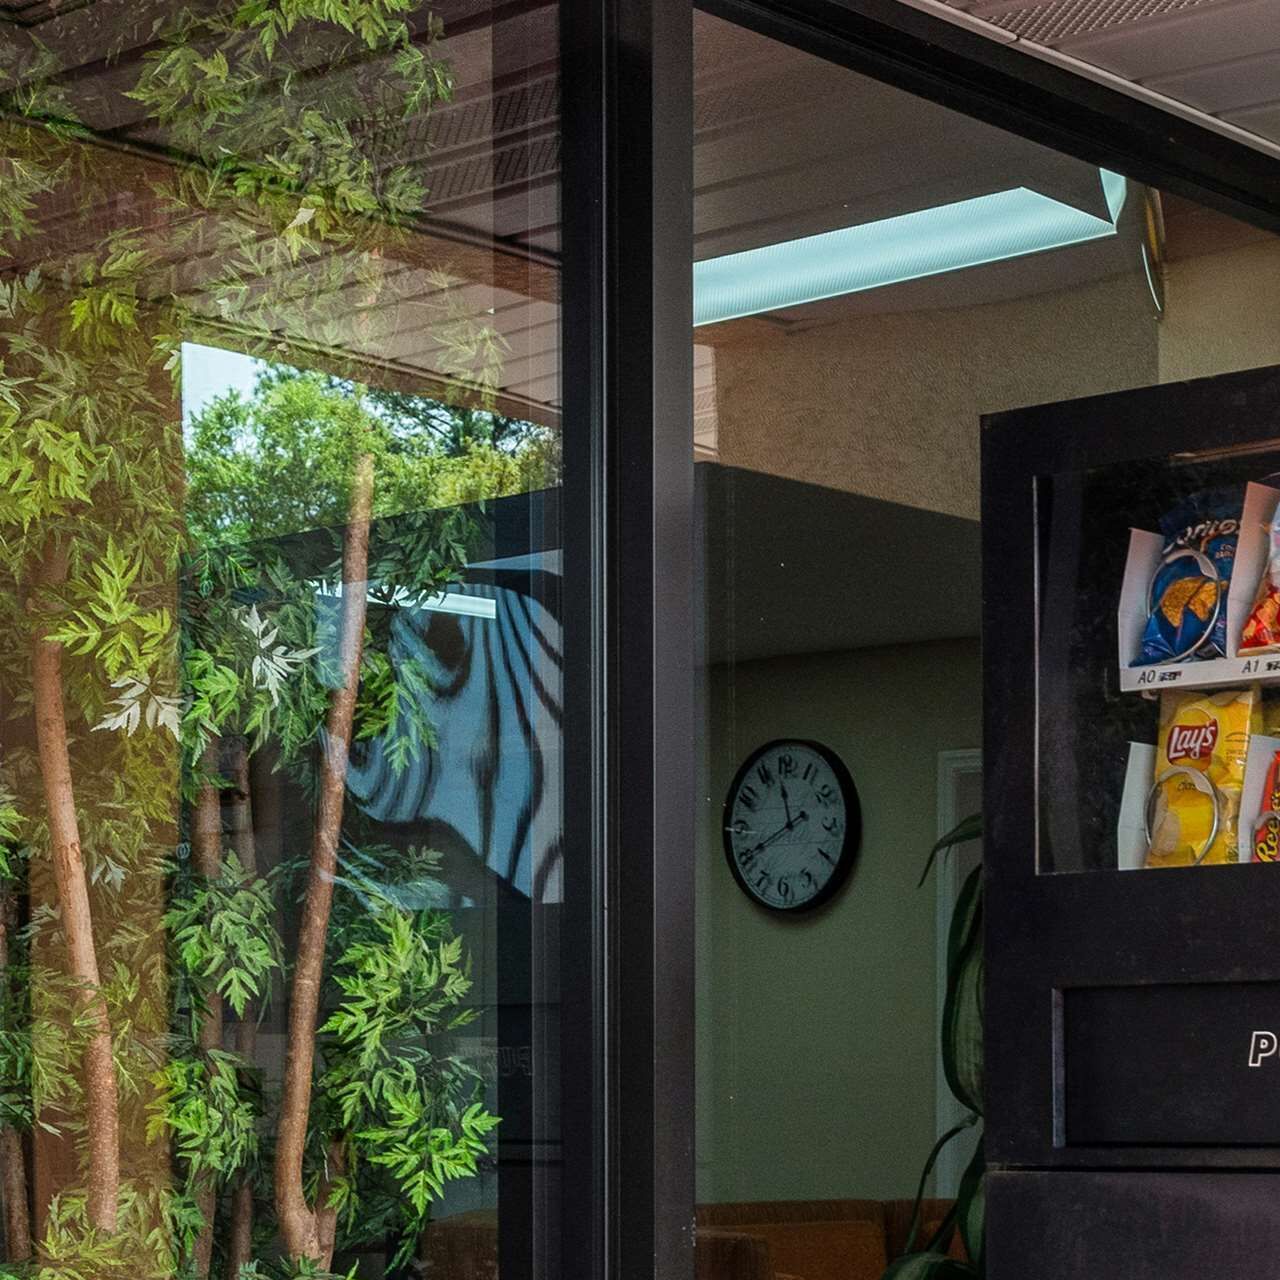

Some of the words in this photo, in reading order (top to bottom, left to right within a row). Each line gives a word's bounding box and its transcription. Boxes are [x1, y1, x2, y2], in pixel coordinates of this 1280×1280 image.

[1242, 659, 1260, 673] A1
[1138, 670, 1155, 684] A0
[1168, 722, 1216, 760] Lay's
